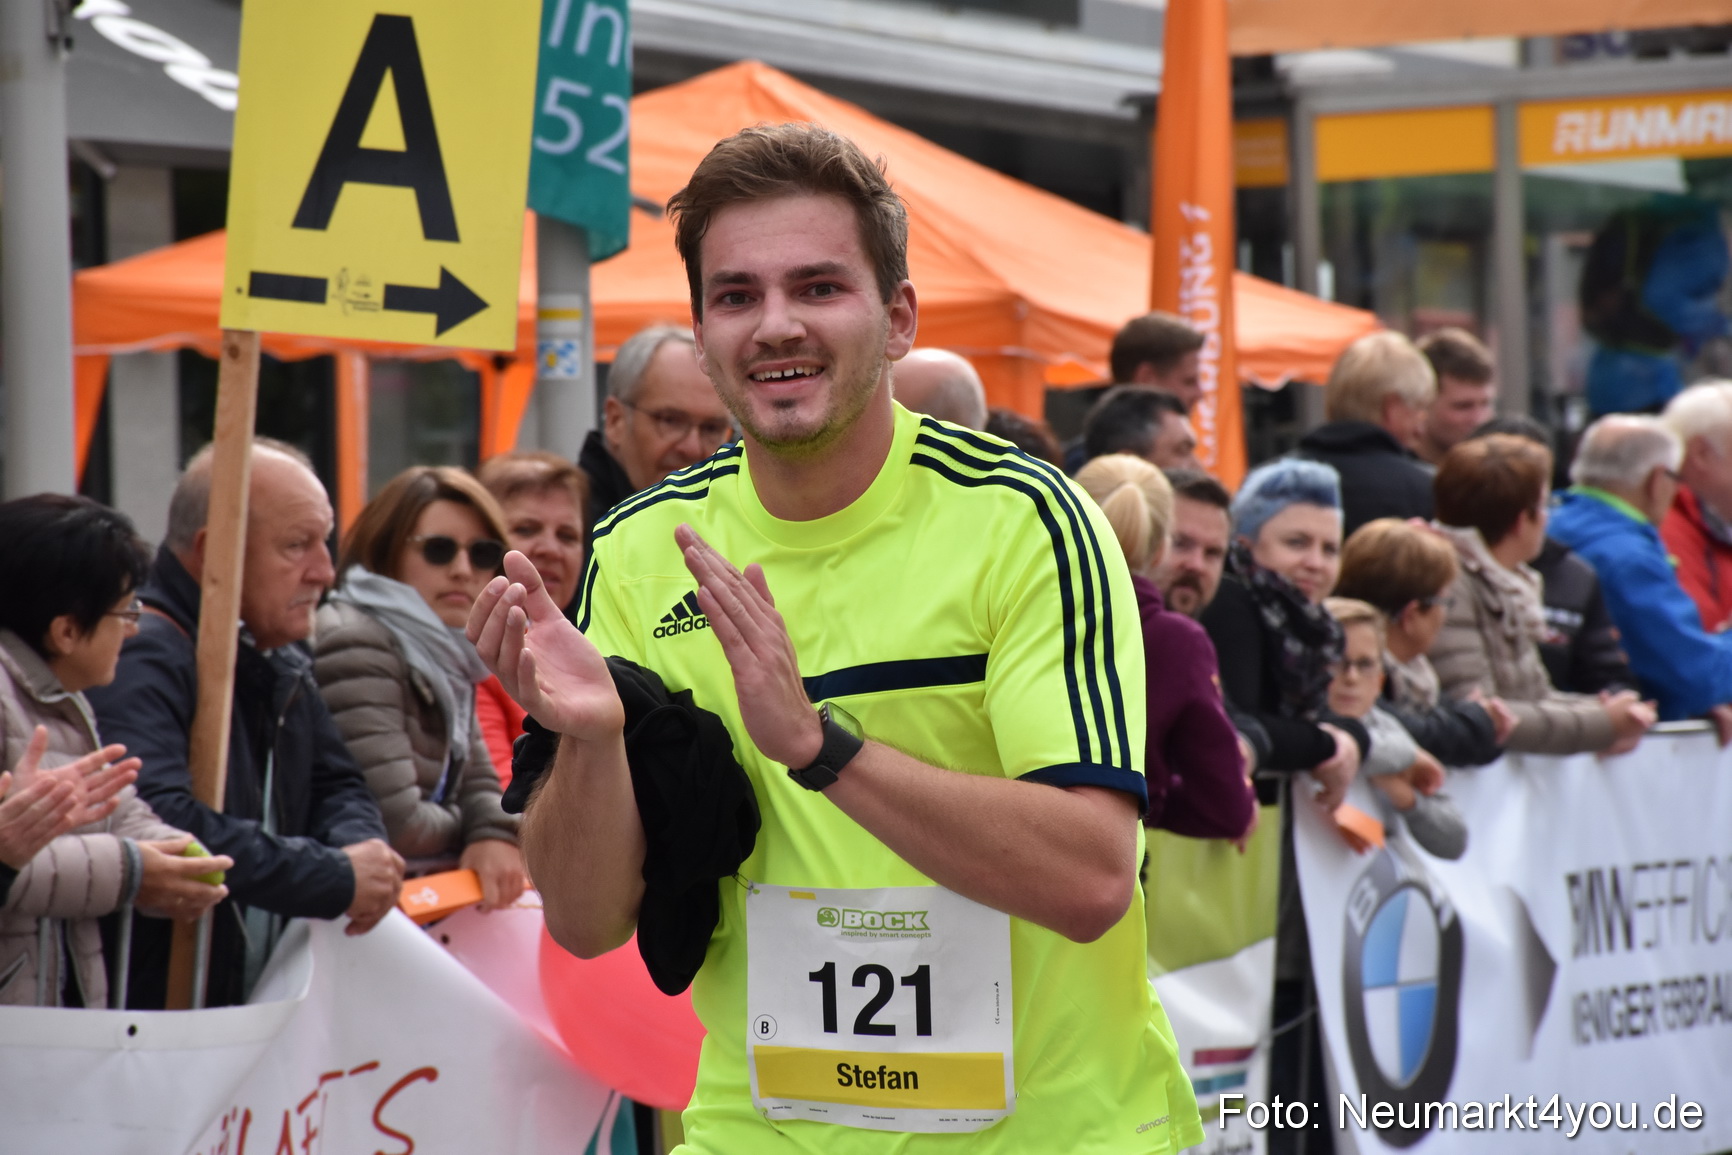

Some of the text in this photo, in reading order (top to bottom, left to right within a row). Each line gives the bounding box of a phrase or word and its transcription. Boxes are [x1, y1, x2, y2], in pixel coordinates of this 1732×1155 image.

[290, 13, 461, 243] A
[533, 76, 630, 175] 52
[841, 908, 931, 931] BOCK
[900, 931, 932, 939] concepts
[808, 961, 932, 1037] 121
[761, 1021, 770, 1034] B
[836, 1062, 919, 1090] Stefan
